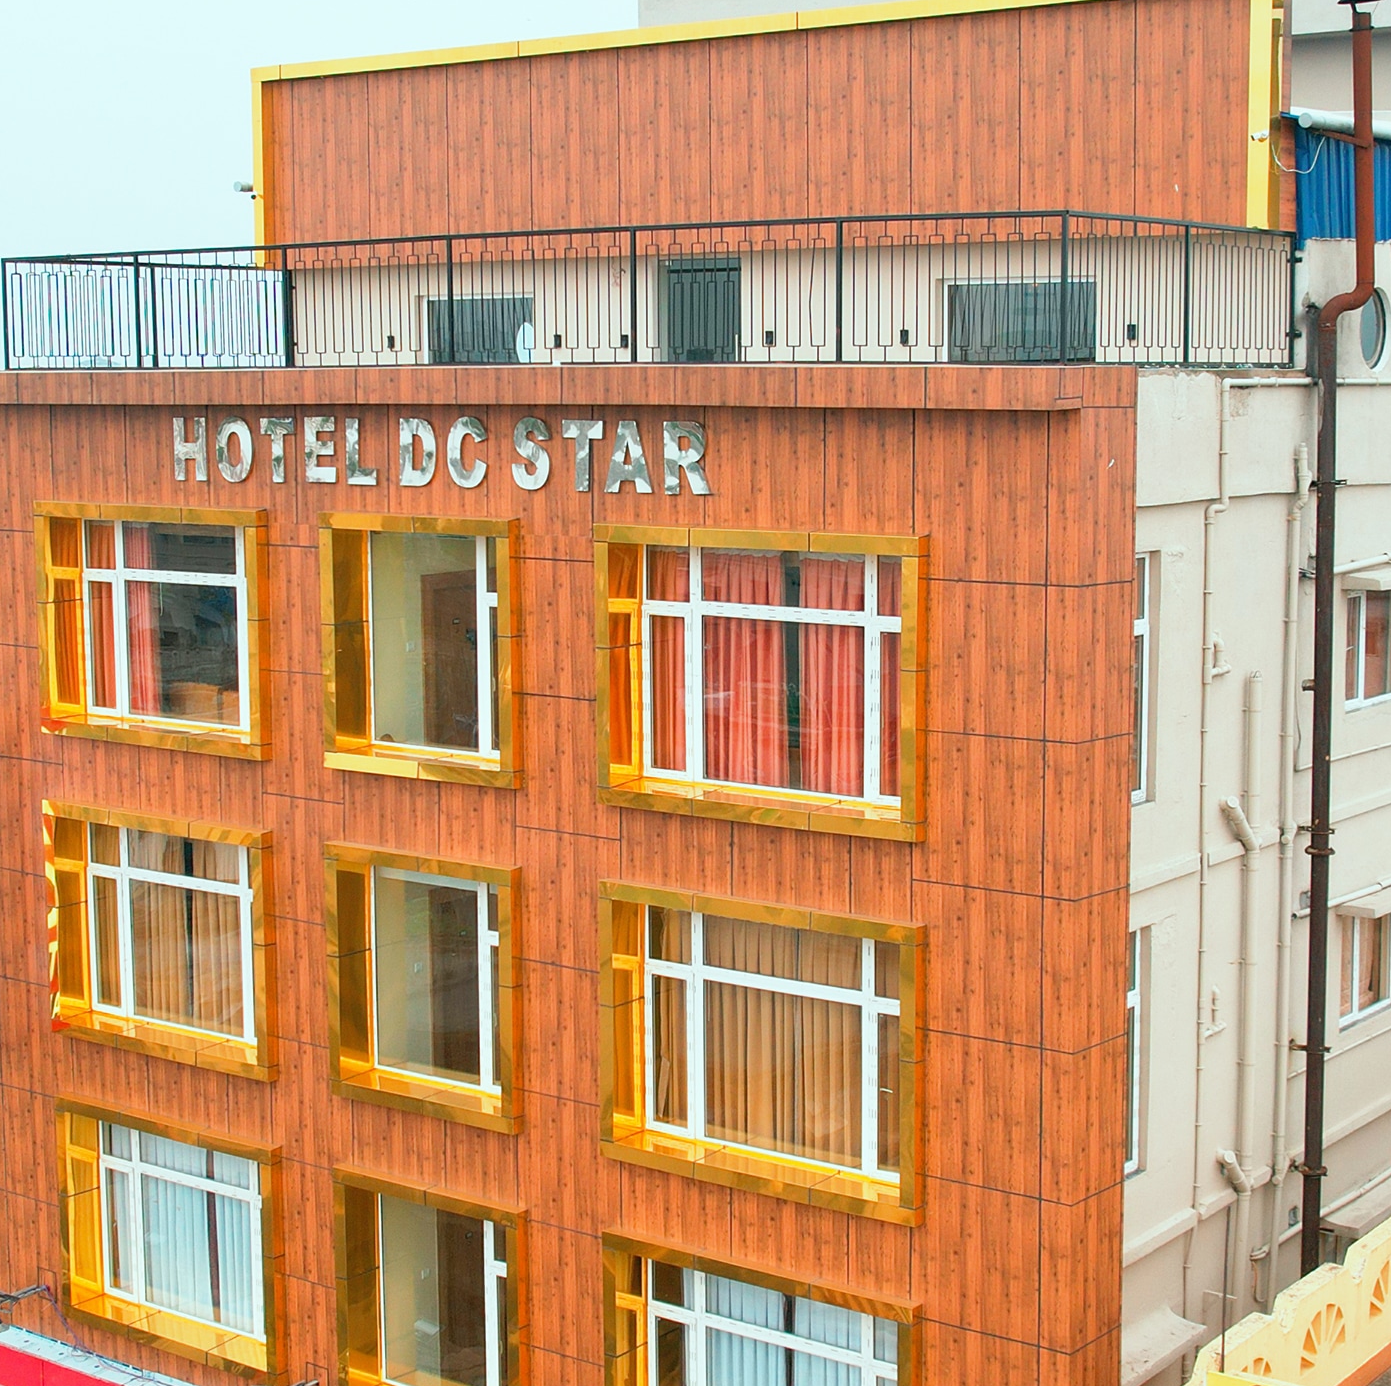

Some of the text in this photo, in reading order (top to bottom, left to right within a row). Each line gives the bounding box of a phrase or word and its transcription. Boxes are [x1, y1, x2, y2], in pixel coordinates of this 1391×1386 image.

[172, 416, 713, 496] HOTEL DC STAR
